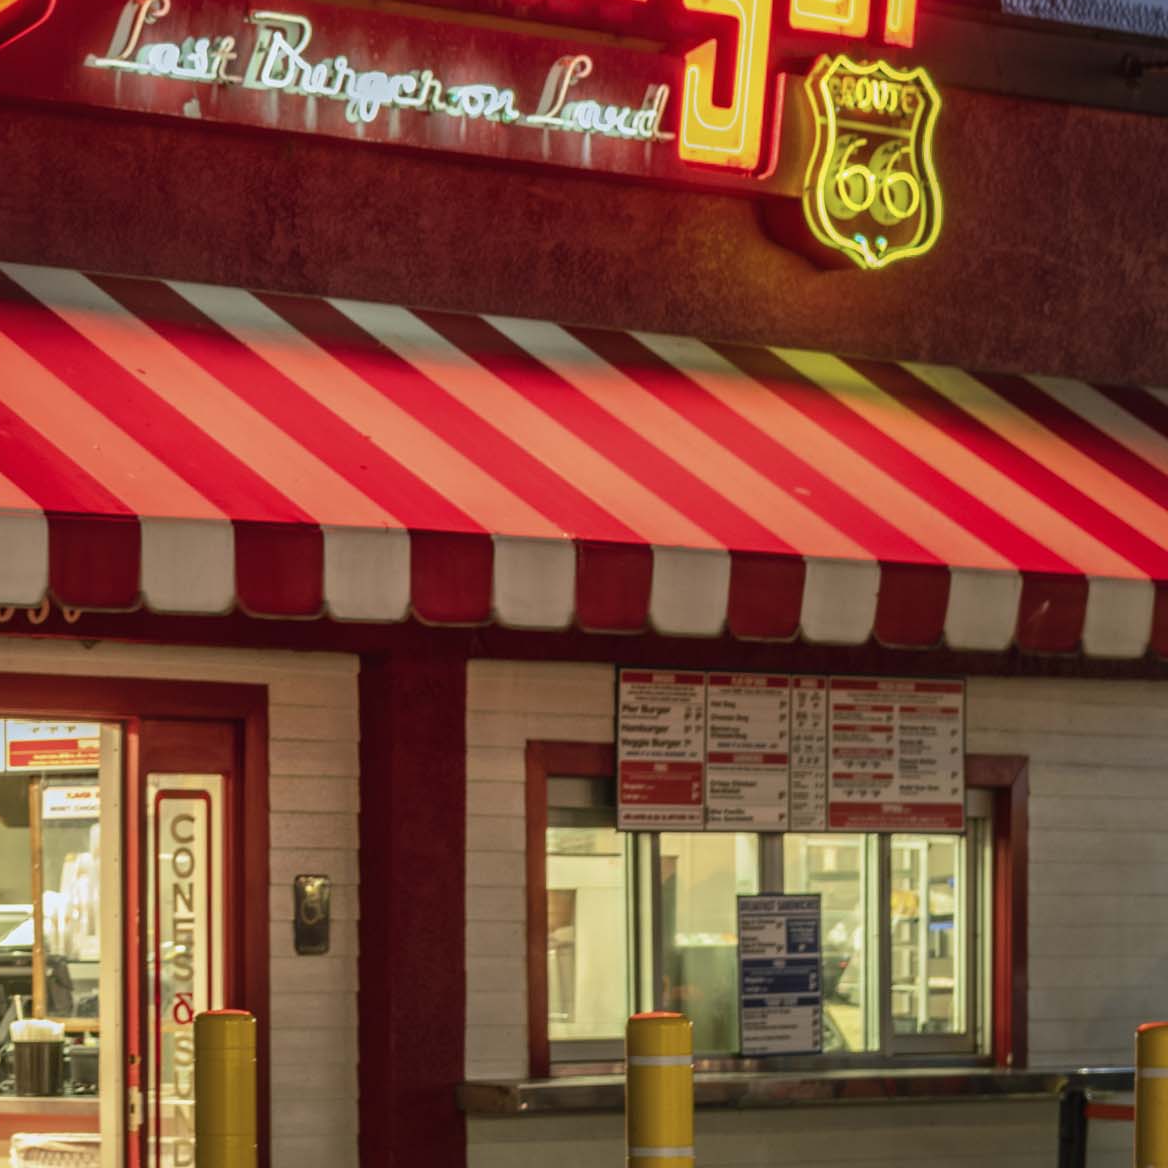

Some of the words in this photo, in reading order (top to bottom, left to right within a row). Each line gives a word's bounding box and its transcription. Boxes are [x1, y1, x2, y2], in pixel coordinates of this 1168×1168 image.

[243, 11, 447, 122] Burger
[446, 83, 520, 120] on
[526, 54, 675, 140] Land
[832, 77, 917, 115] ROUTE
[826, 134, 920, 225] 66
[170, 813, 196, 983] CONES
[173, 992, 194, 1025] &
